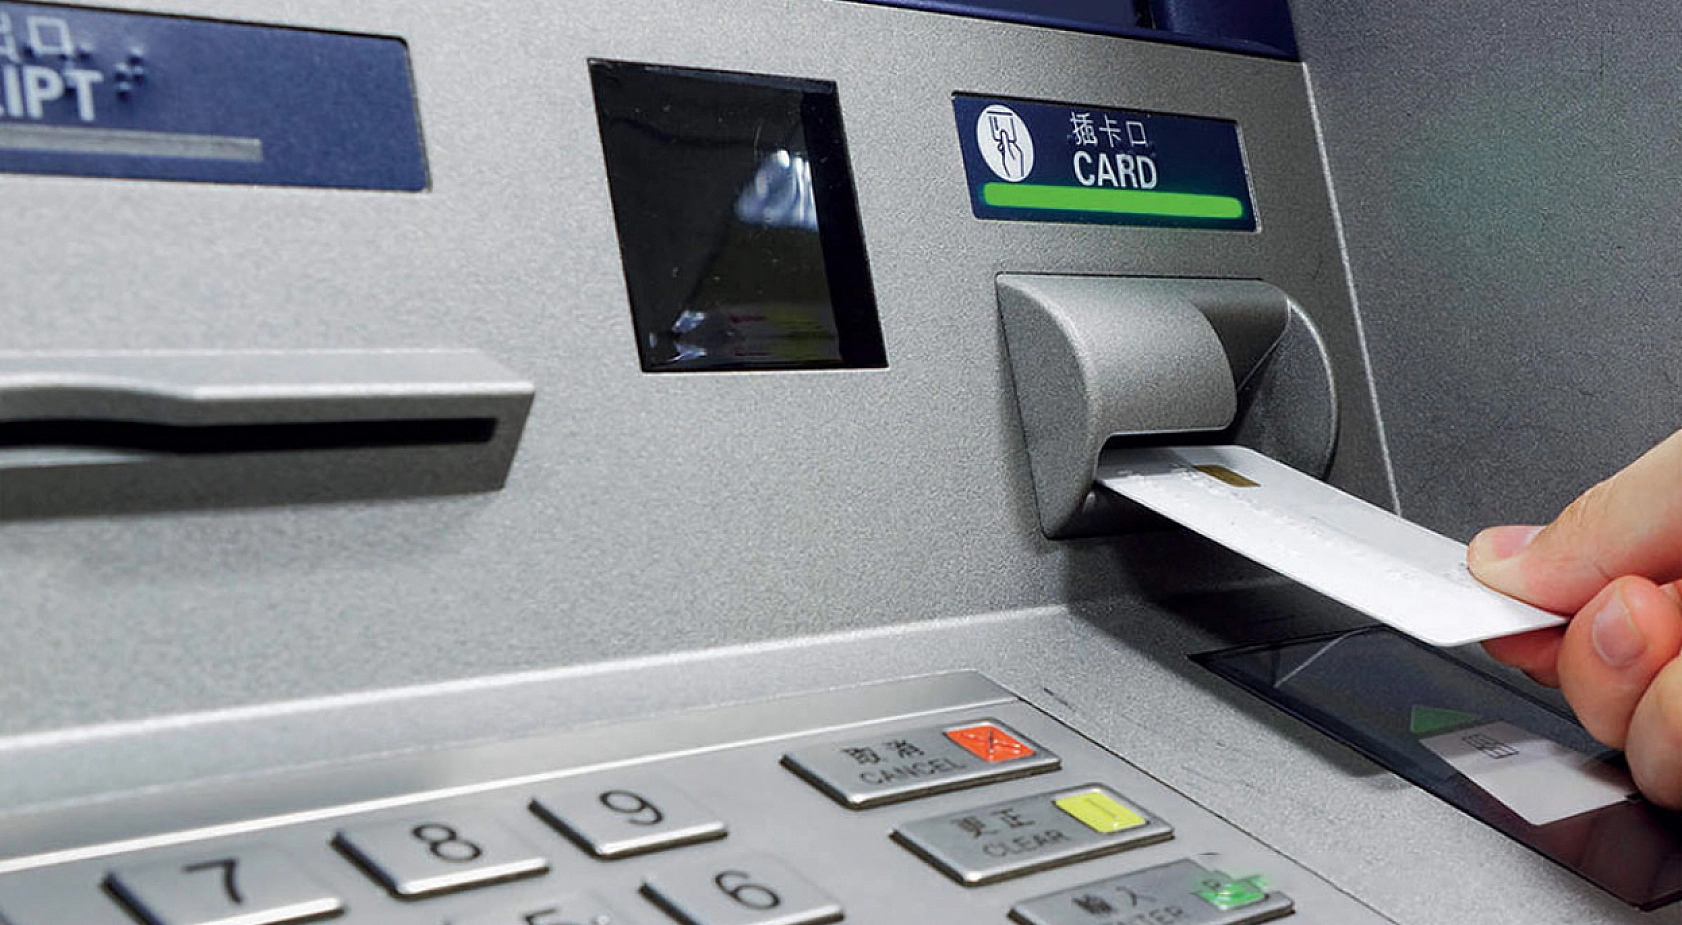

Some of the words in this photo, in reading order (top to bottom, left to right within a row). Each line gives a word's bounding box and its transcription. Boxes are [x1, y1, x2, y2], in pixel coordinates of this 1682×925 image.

[0, 64, 104, 122] IPT
[1069, 111, 1149, 148] 插卡口
[1073, 150, 1158, 190] CARD
[859, 757, 968, 785] CANCEL
[599, 789, 663, 825] 9
[411, 823, 482, 863] 8
[981, 829, 1073, 857] CLEAR
[181, 857, 244, 905] 7
[715, 869, 782, 910] 6
